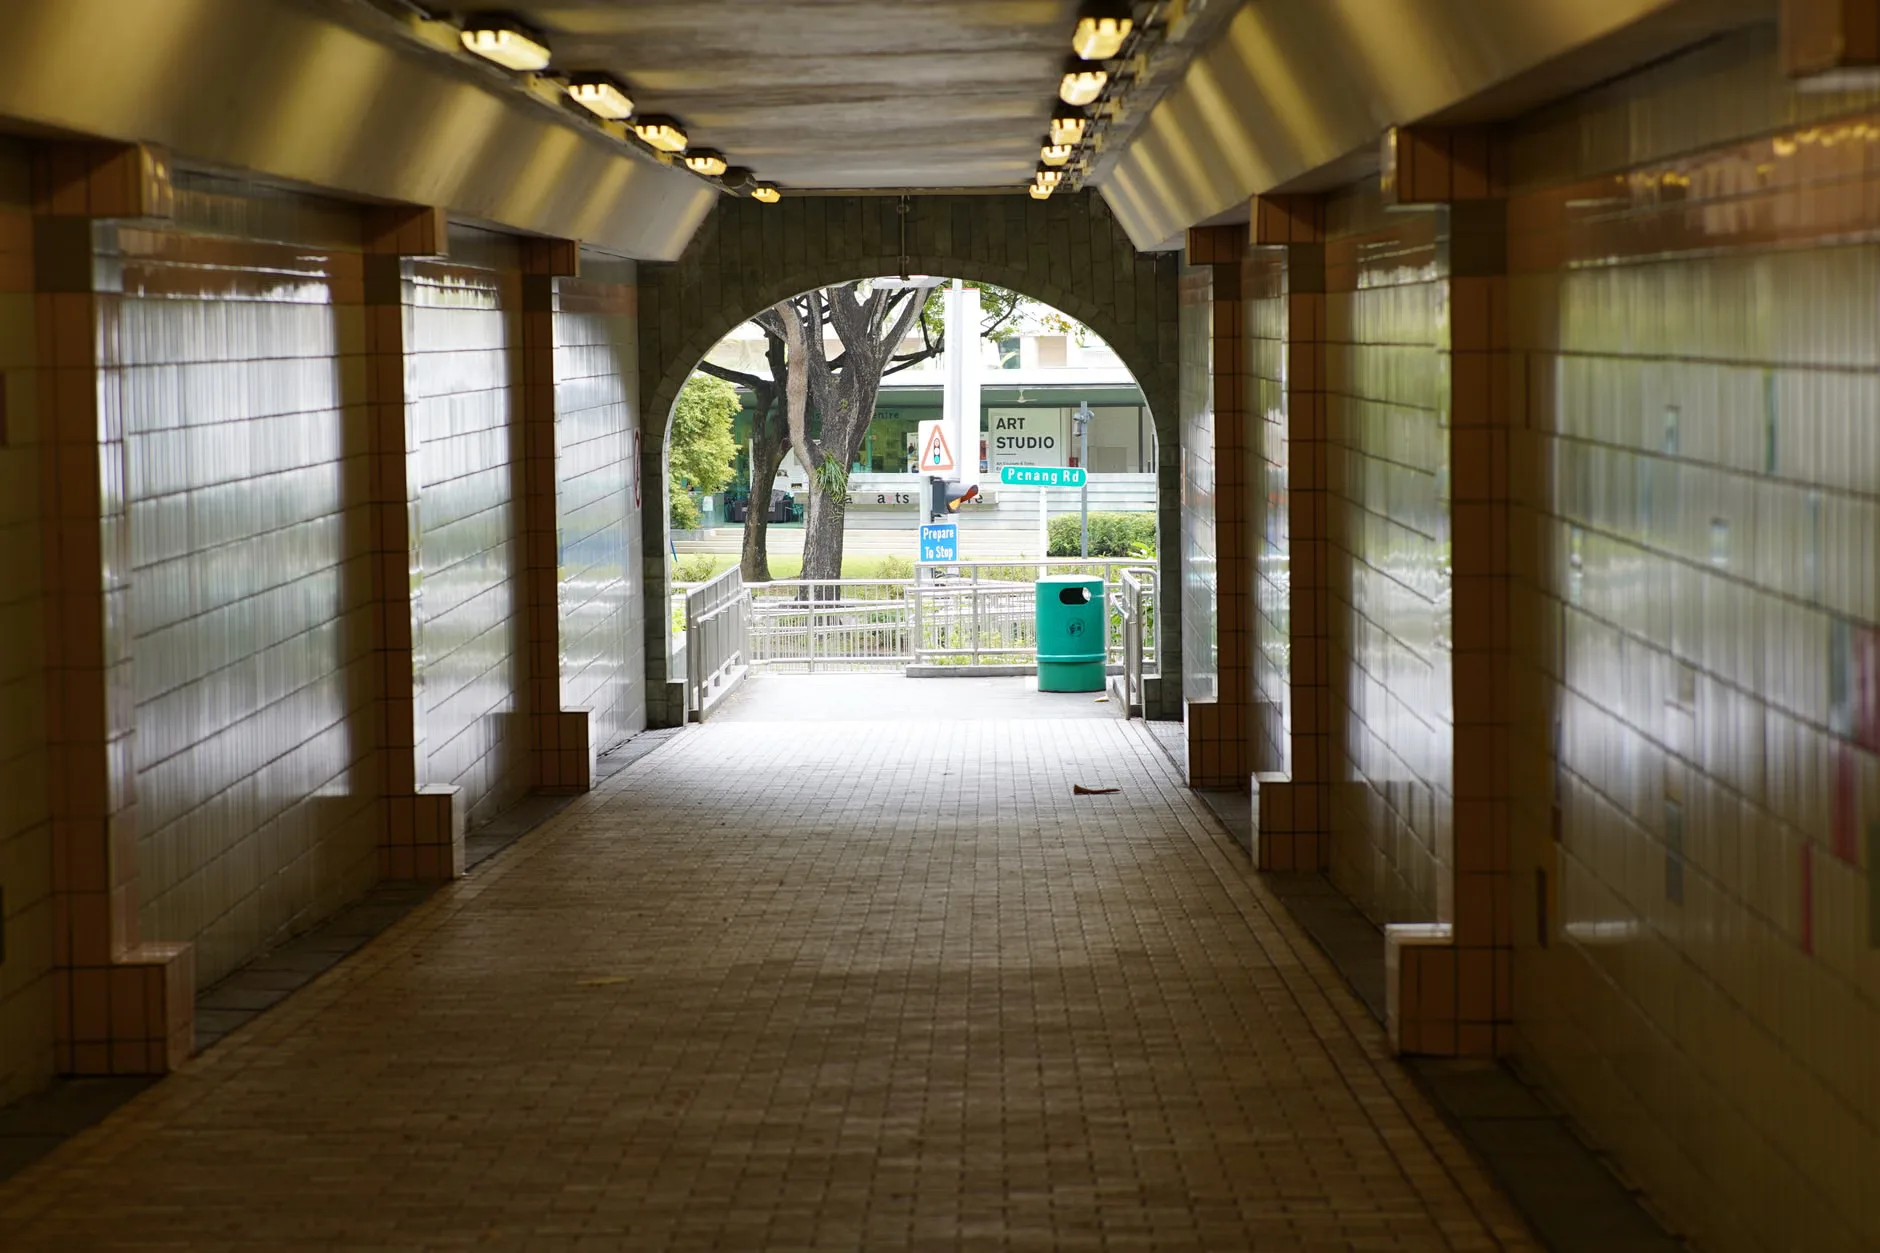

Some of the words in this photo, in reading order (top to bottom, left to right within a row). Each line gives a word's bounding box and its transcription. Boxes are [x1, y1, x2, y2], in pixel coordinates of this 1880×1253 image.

[996, 417, 1025, 430] ART
[996, 436, 1055, 449] STUDIO
[1007, 468, 1058, 484] Penang
[1062, 470, 1080, 483] Rd
[923, 527, 954, 542] Prepare
[924, 546, 934, 560] To
[935, 545, 953, 561] Stop
